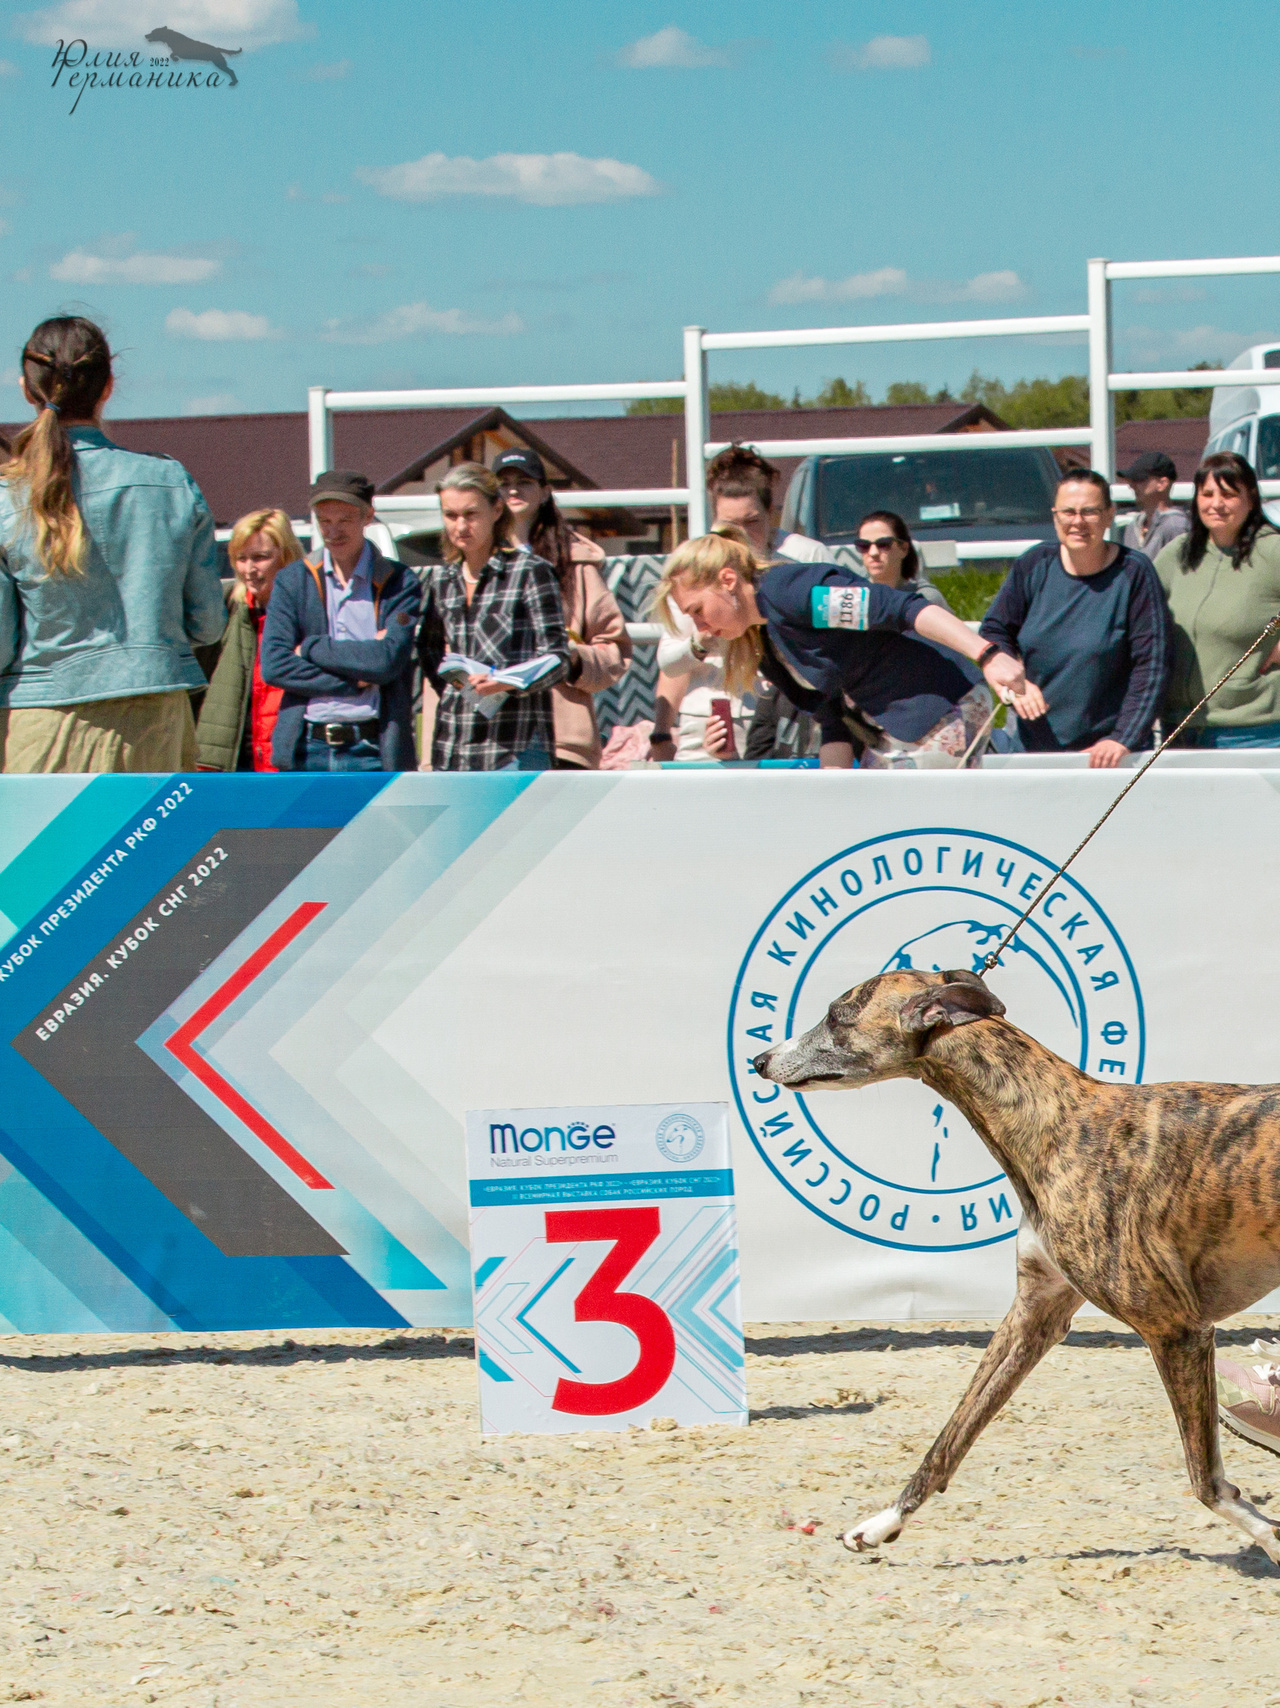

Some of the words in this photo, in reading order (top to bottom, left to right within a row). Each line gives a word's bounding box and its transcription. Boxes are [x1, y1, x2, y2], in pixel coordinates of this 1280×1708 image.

[840, 592, 854, 623] 1186
[0, 934, 43, 982] КУБОК
[39, 849, 129, 936] ПРЕЗИДЕНТА
[124, 817, 158, 849] РКФ
[156, 782, 193, 818] 2022
[35, 972, 109, 1041] ЕВРАЗИЯ.
[105, 916, 160, 969] КУБОК
[158, 884, 188, 916] СНГ
[187, 847, 229, 887] 2022
[767, 846, 1120, 992] КИНОЛОГИЧЕСКАЯ
[490, 1154, 532, 1168] Natural
[533, 1152, 619, 1168] Superpremium
[746, 990, 910, 1231] РОССИЙСАЯ
[544, 1206, 676, 1417] 3
